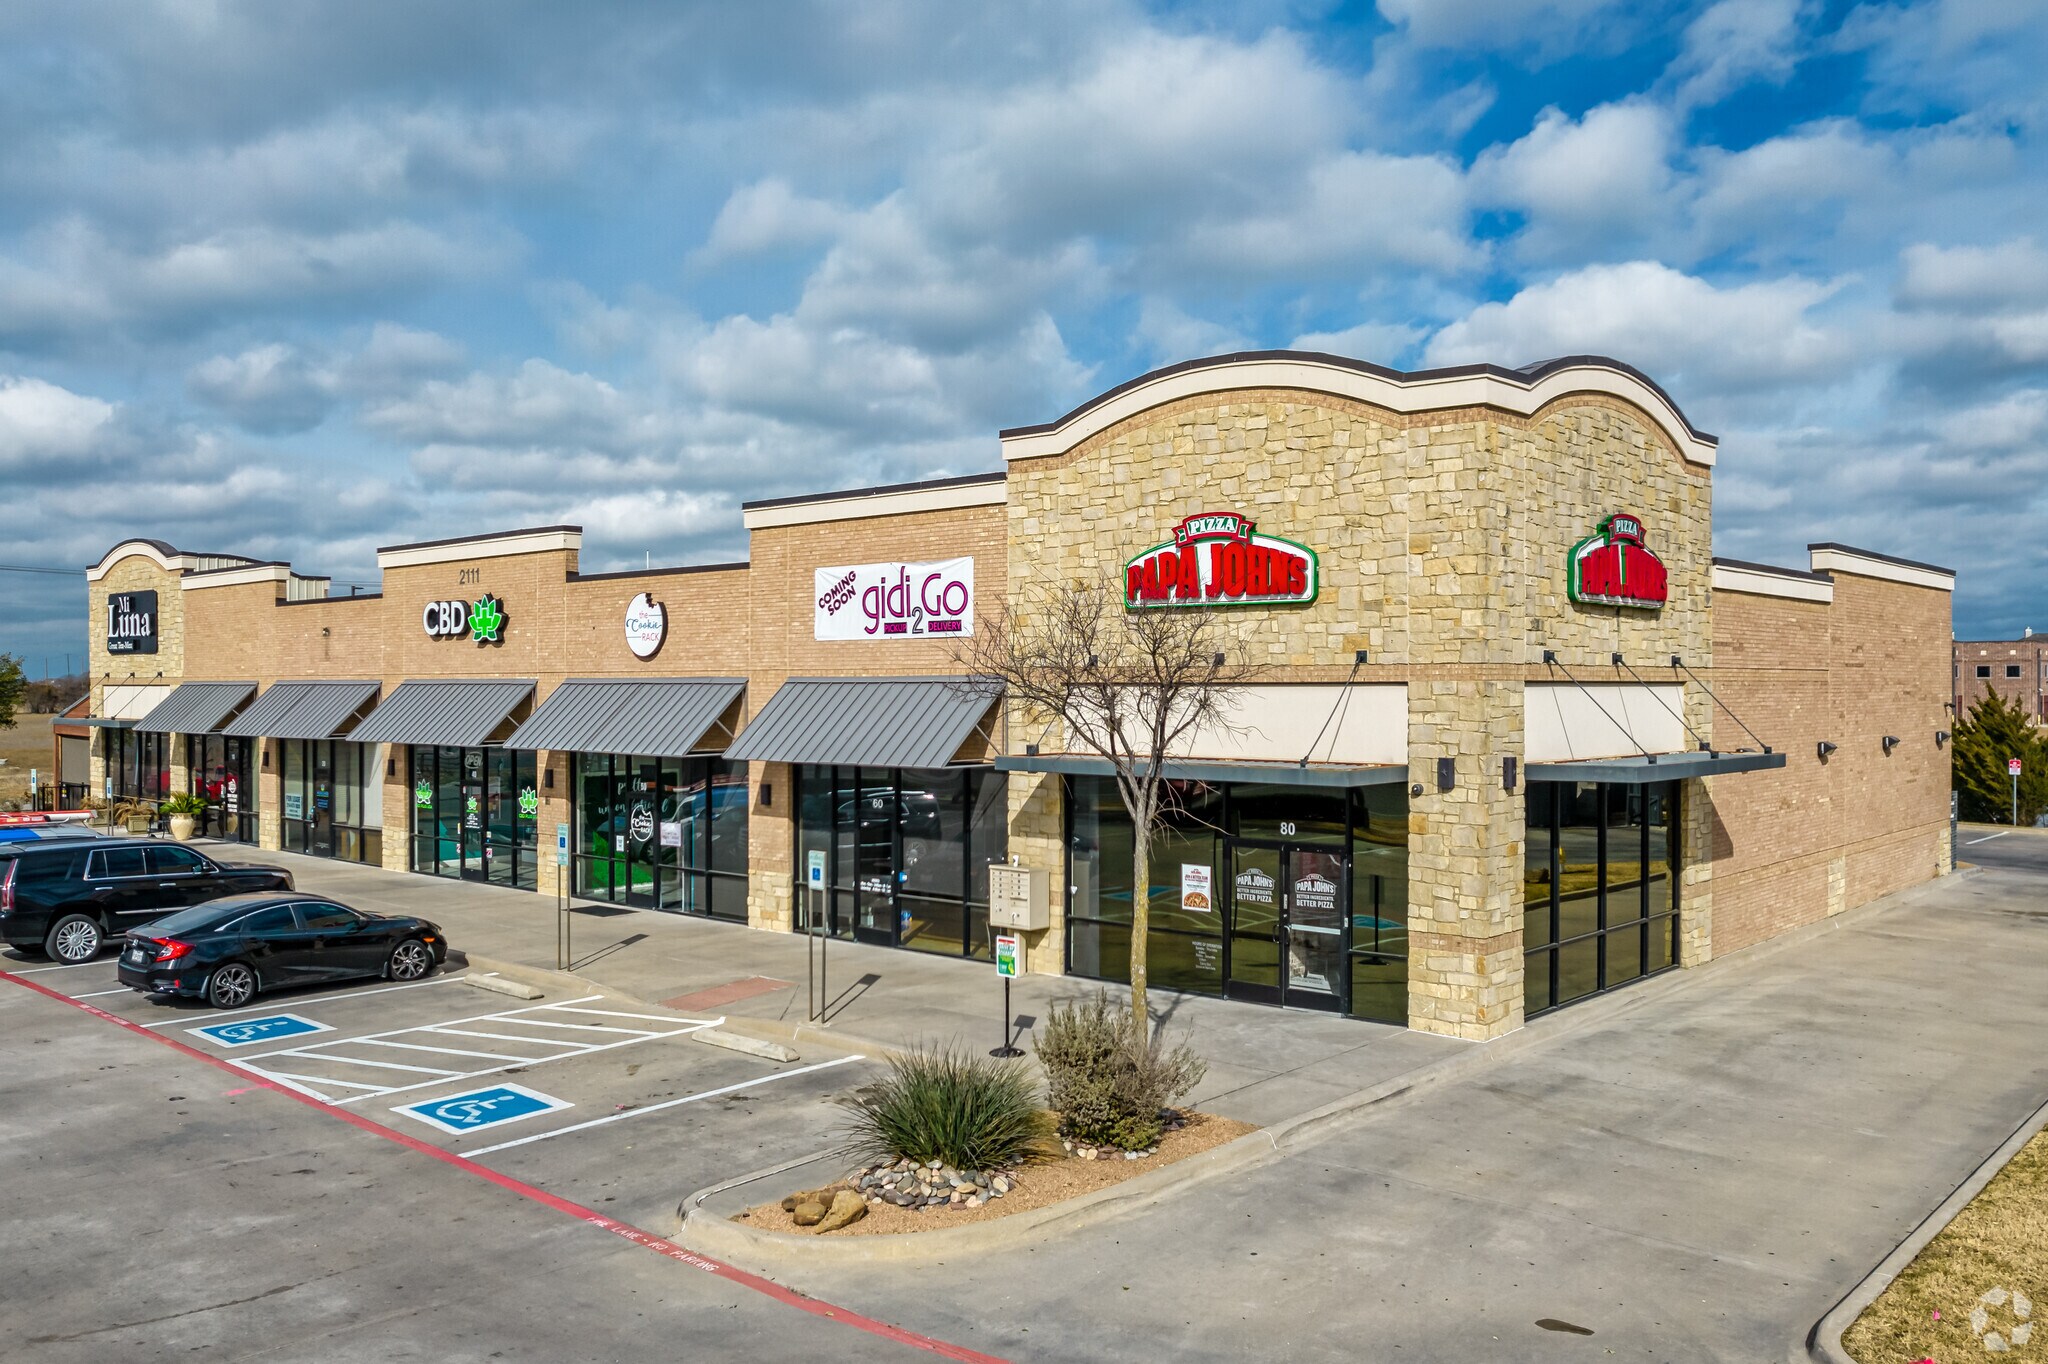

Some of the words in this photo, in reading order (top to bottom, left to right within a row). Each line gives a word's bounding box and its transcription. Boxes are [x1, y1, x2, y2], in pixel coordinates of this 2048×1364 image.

[1190, 517, 1236, 535] PIZZA
[1615, 519, 1639, 536] PIZZA
[459, 568, 480, 585] 2111
[1127, 545, 1200, 600] PAPA
[818, 570, 858, 609] COMING
[118, 596, 130, 613] Mi
[827, 585, 857, 617] SOON
[107, 604, 151, 638] Luna
[423, 601, 465, 635] CBD
[638, 610, 649, 619] the
[626, 618, 662, 632] Cookie
[885, 623, 907, 633] PICKUP
[928, 620, 962, 632] DELIVERY
[641, 632, 660, 641] RACK
[872, 799, 884, 809] 60
[633, 818, 652, 827] Cookie
[1280, 822, 1296, 836] 80
[1237, 875, 1252, 886] PAPA
[1296, 881, 1312, 892] PAPA
[1237, 893, 1256, 901] BETTER
[1296, 899, 1317, 908] BETTER
[611, 1226, 643, 1240] LANE
[647, 1241, 669, 1251] NO
[669, 1250, 720, 1272] PARKING
